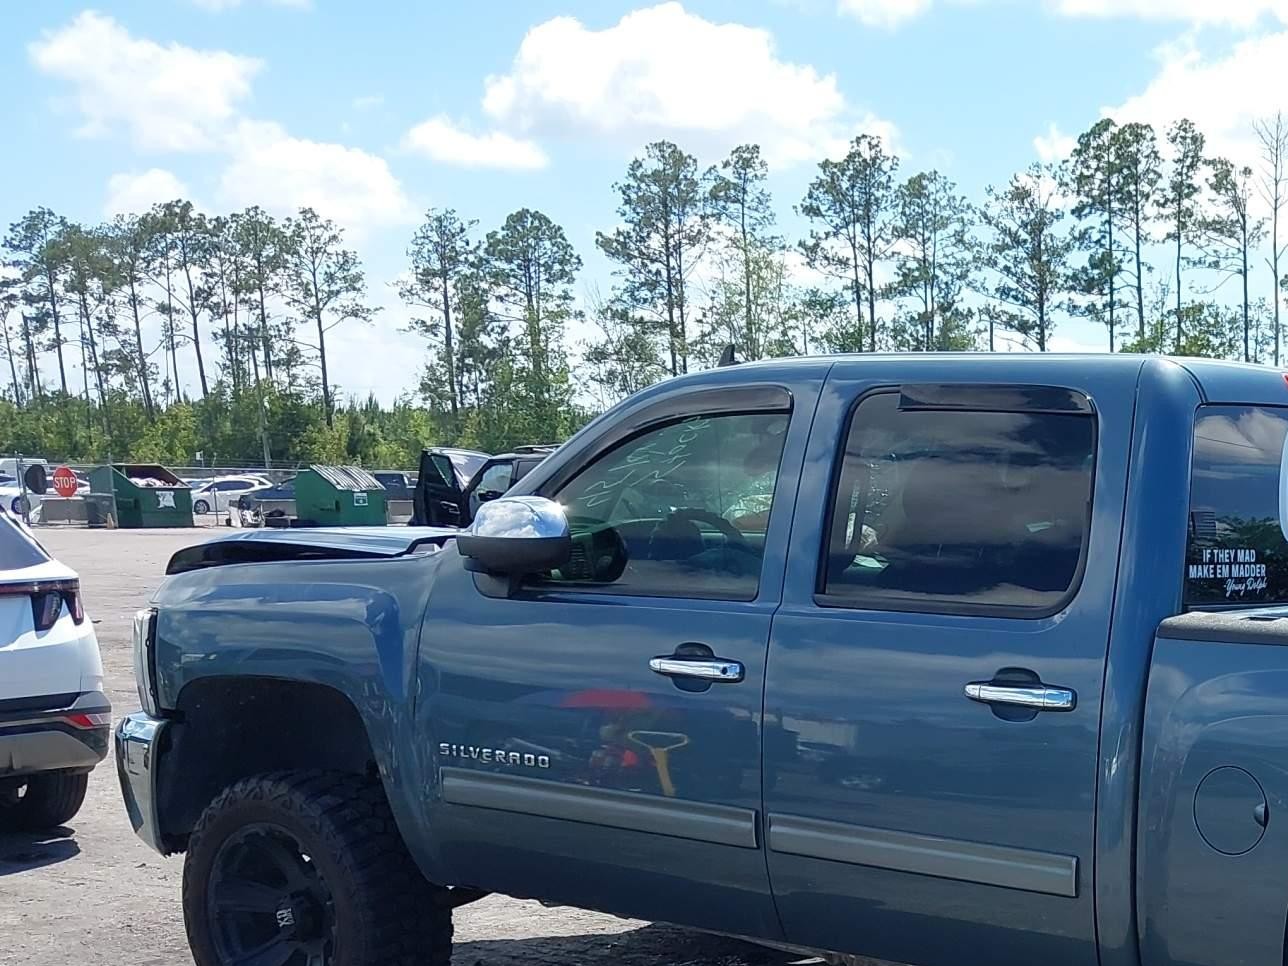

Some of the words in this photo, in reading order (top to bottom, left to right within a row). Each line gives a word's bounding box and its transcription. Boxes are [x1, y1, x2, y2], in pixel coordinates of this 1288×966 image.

[55, 476, 75, 488] STOP
[1203, 549, 1211, 562] IF
[1213, 549, 1235, 562] THEY
[1237, 549, 1256, 562] MAD
[1189, 565, 1214, 578] MAKE
[1217, 564, 1229, 577] EM
[1232, 564, 1266, 577] MADDER
[440, 743, 549, 768] SILVERADO
